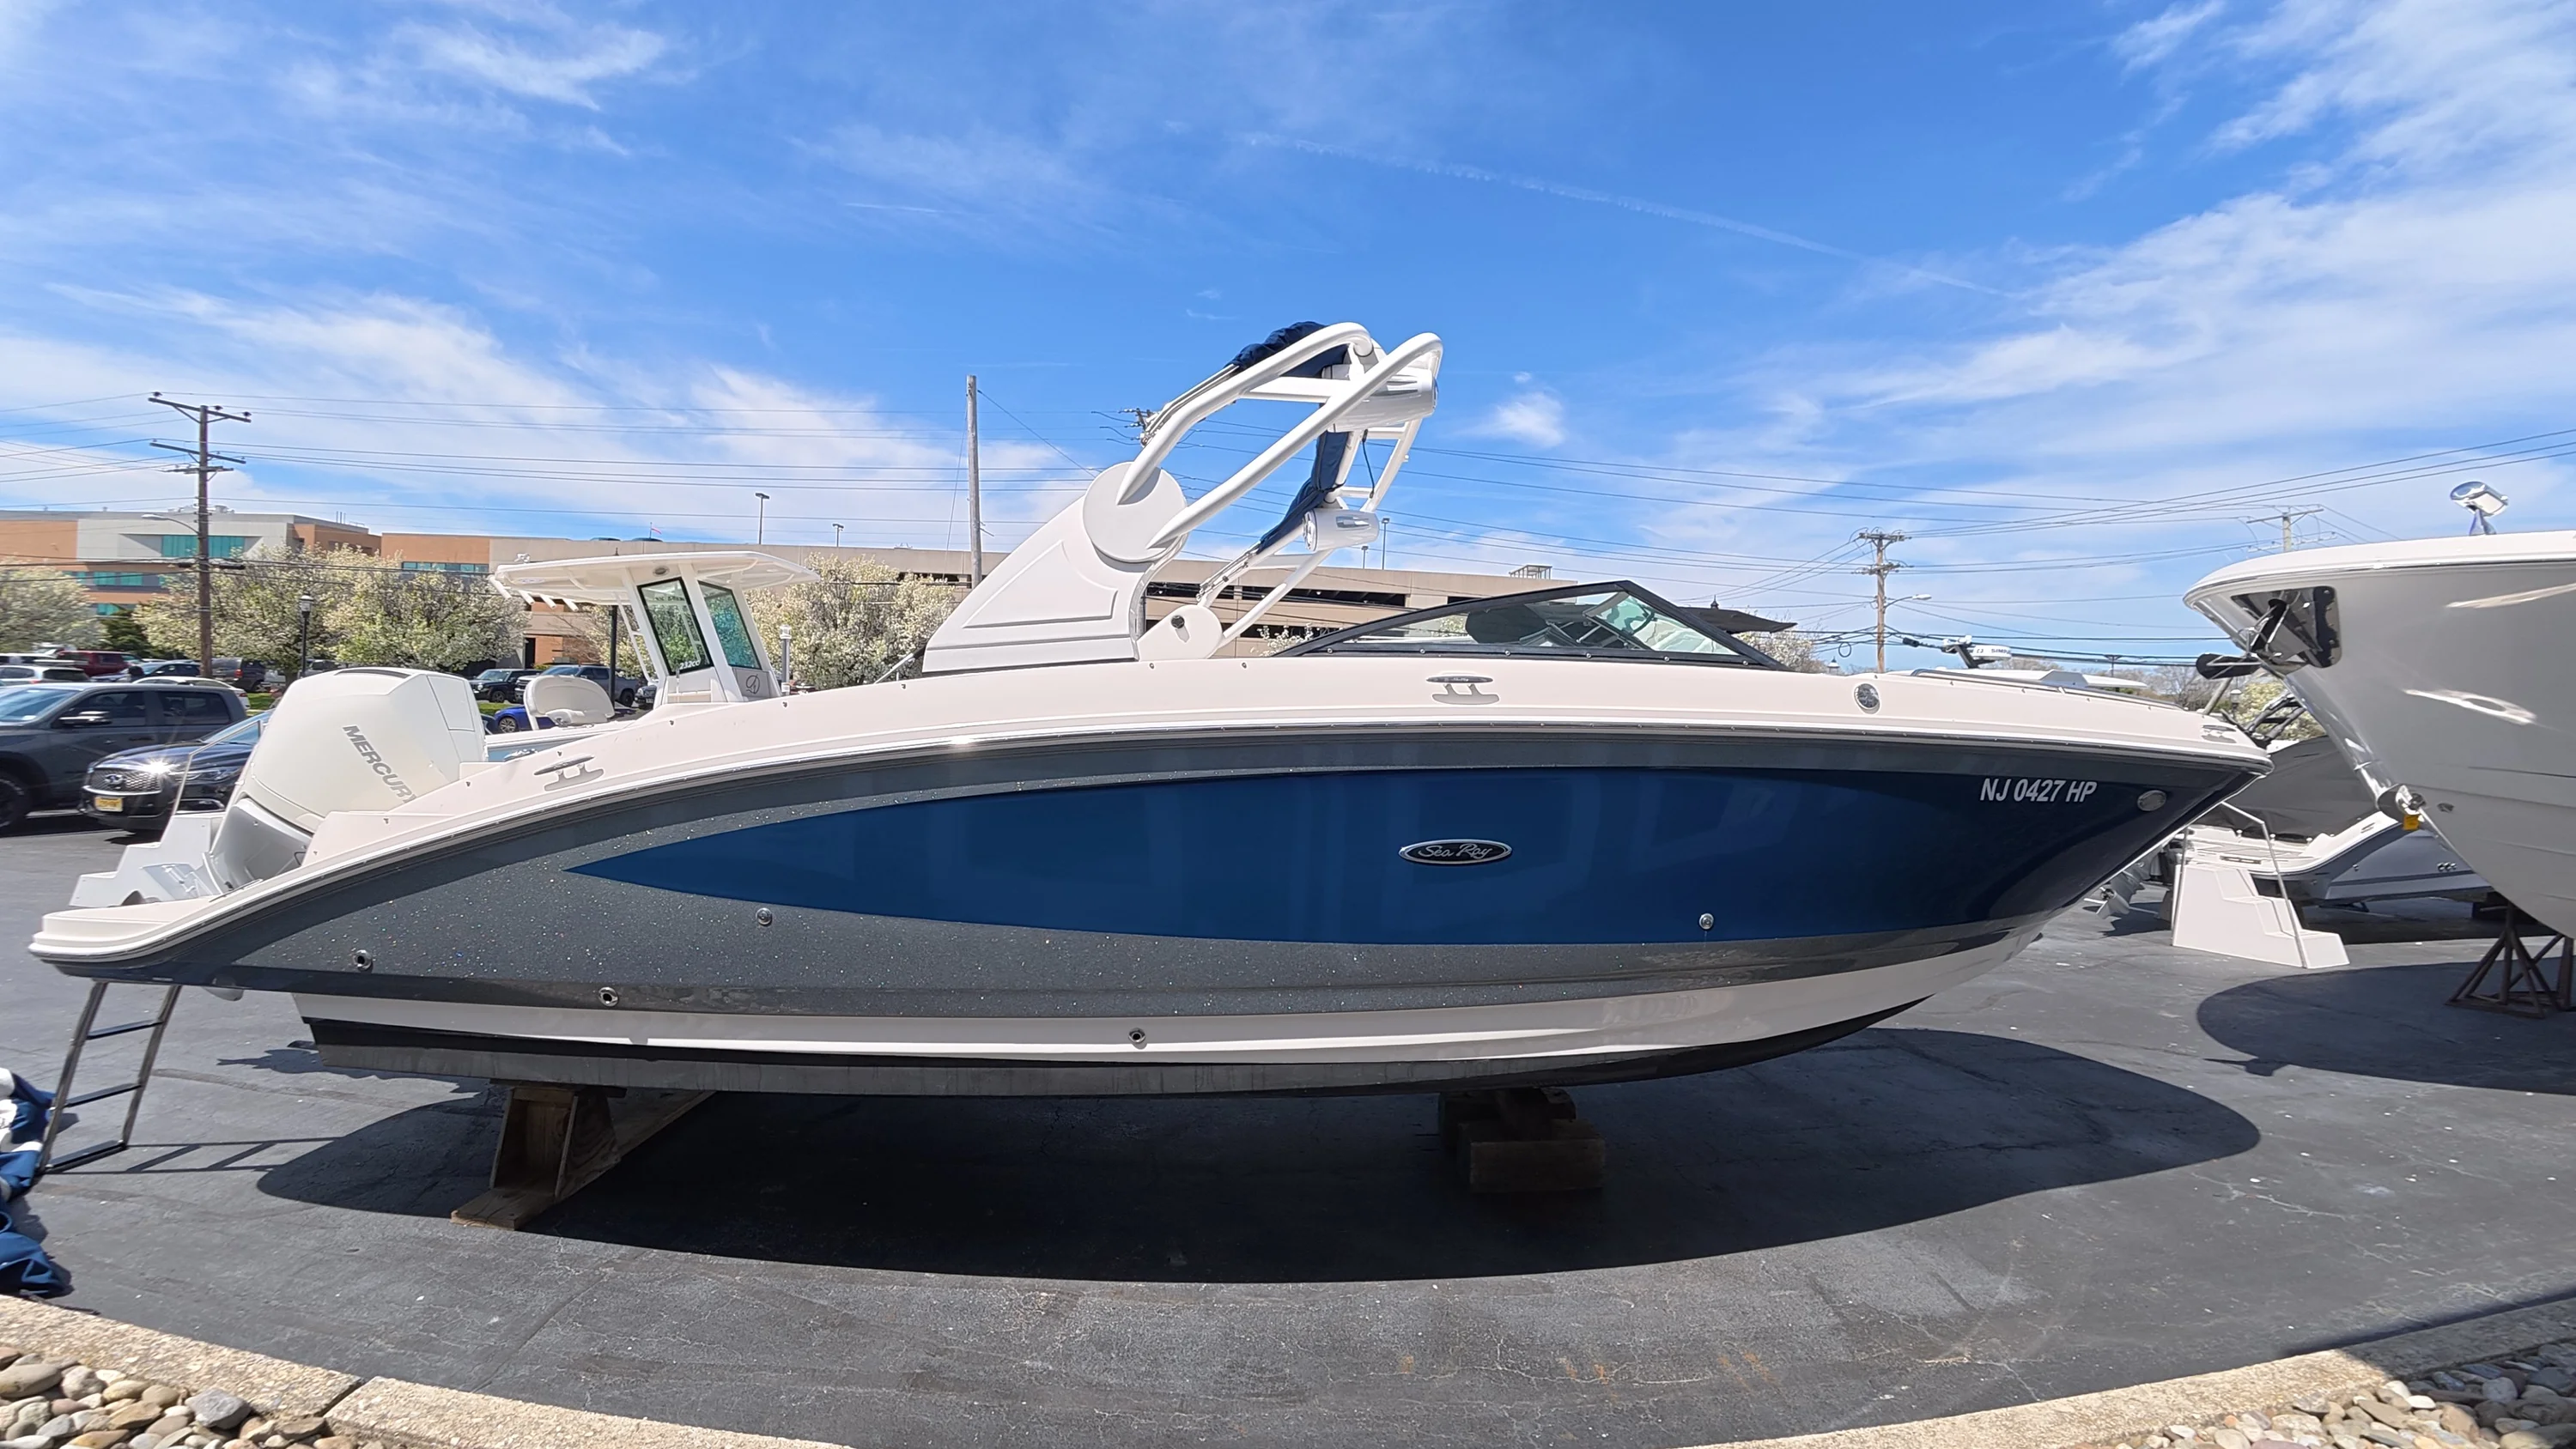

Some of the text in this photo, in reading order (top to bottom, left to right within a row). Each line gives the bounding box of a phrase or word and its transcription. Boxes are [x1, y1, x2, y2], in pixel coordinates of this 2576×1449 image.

[1980, 779, 2098, 802] NJ 0427 HP
[1418, 843, 1492, 860] Sea Ray
